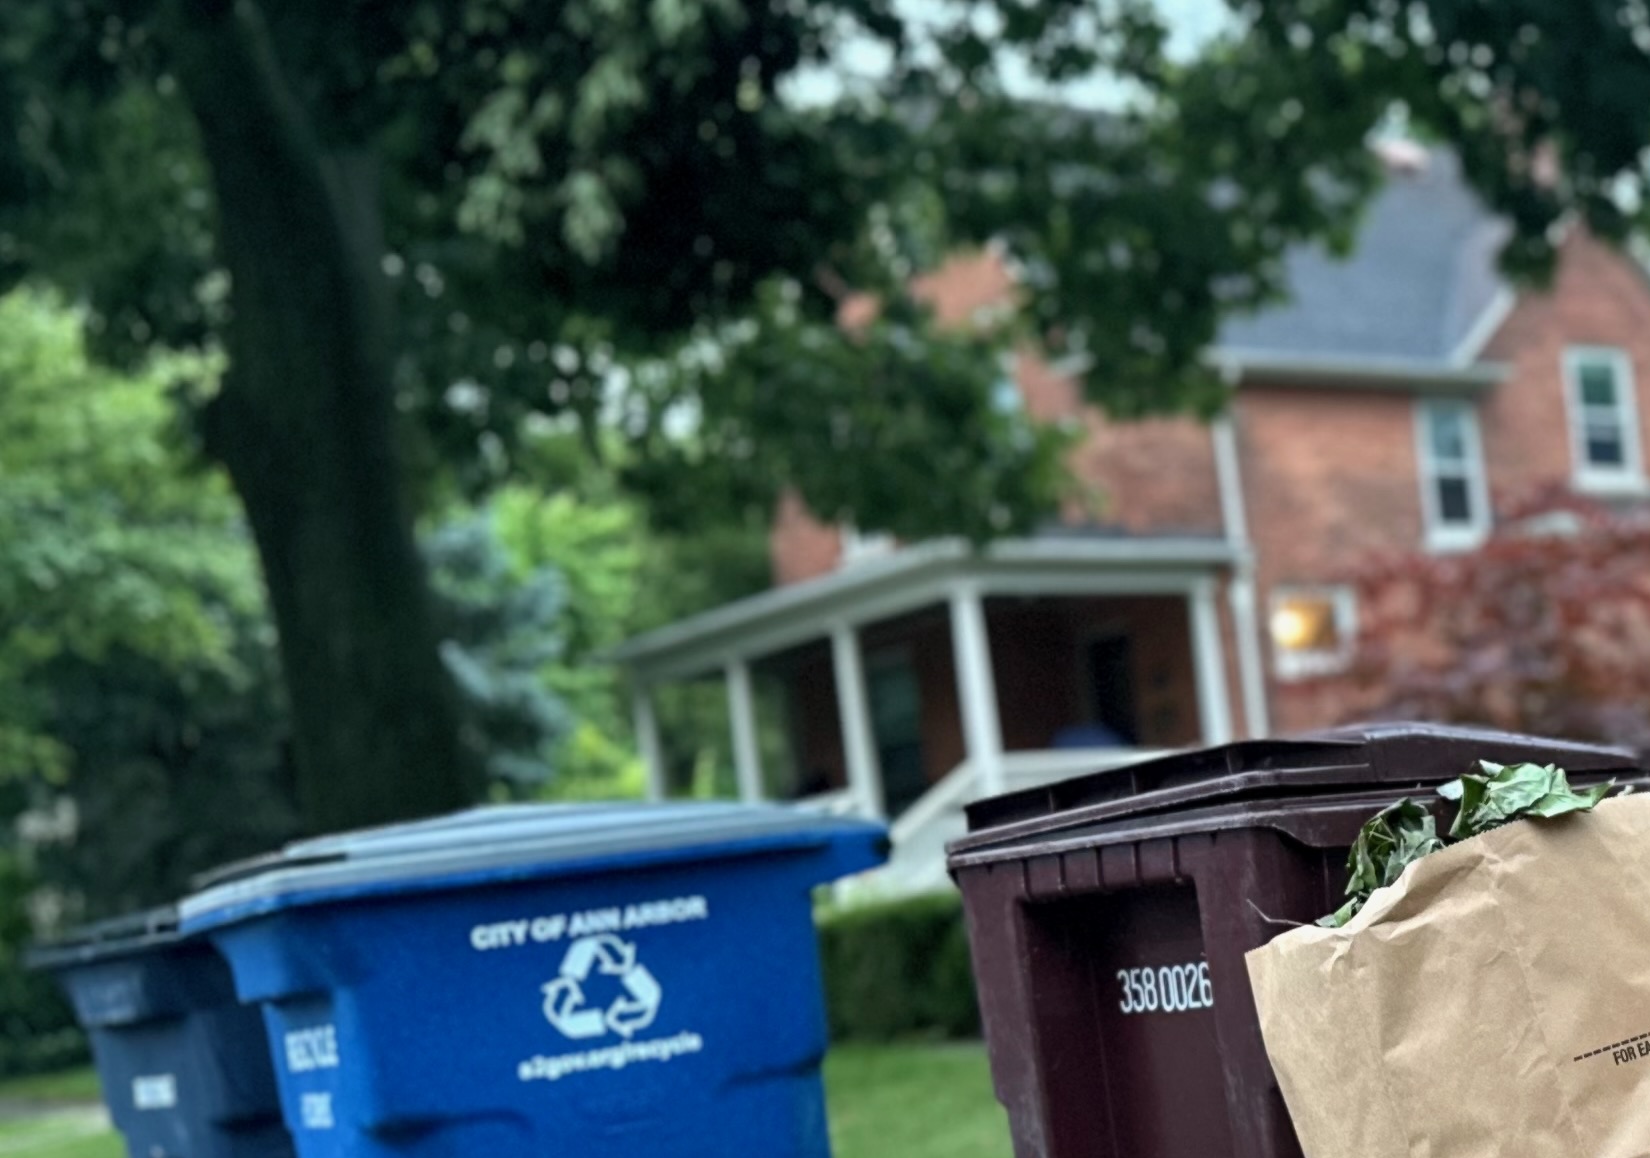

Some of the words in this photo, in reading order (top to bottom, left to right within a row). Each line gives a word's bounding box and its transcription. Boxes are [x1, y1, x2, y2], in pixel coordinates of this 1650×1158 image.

[470, 920, 529, 950] CITY
[530, 914, 568, 942] OF
[568, 907, 622, 938] ANN
[623, 895, 708, 930] ARBOR
[1613, 1045, 1637, 1066] FOR
